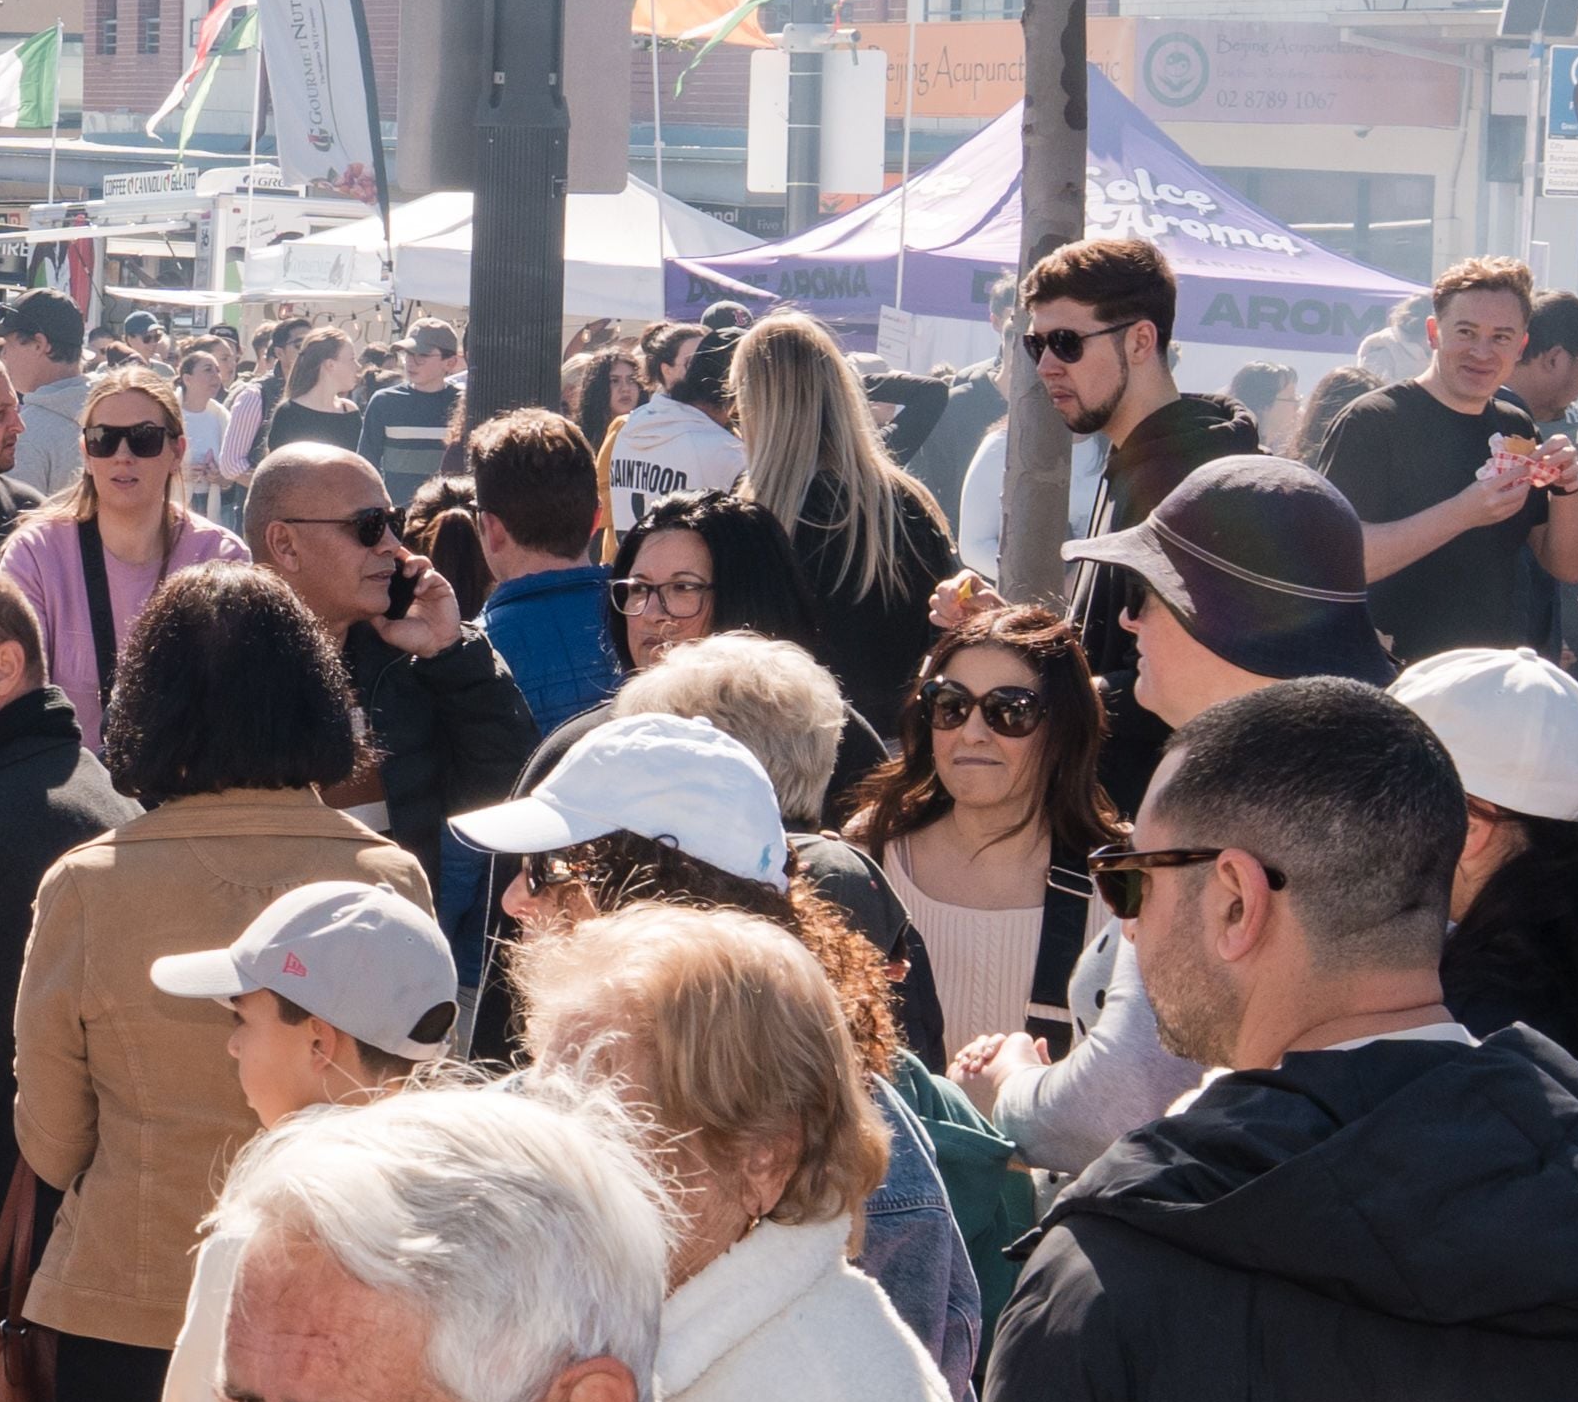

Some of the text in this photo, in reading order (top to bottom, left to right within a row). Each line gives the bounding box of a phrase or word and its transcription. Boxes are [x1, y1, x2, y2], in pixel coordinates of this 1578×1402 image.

[1216, 33, 1270, 60] Beijing
[299, 41, 324, 126] GOURMET
[932, 45, 1026, 99] Acupunct
[1216, 88, 1338, 111] 02 8789 1067
[1549, 142, 1564, 150] City
[104, 177, 127, 196] COFFEE
[134, 174, 162, 194] CANNOLI
[757, 218, 780, 232] Five
[776, 263, 871, 298] AROMA
[1199, 292, 1386, 337] AROM
